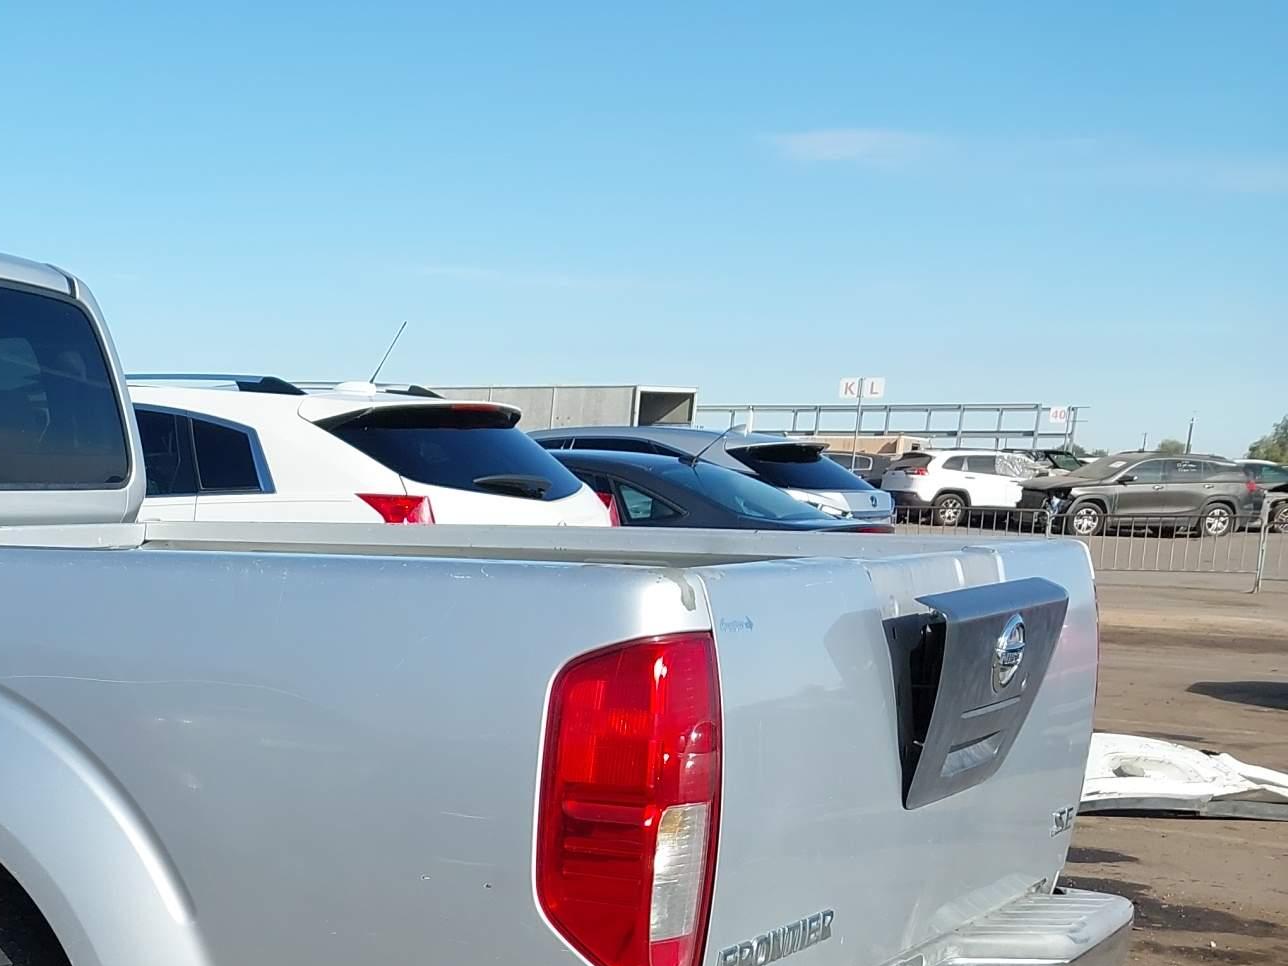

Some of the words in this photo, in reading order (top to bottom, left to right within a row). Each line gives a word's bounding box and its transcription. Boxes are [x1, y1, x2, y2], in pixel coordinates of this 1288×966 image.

[844, 381, 855, 395] K
[870, 381, 879, 395] L
[1051, 409, 1066, 420] 40
[1049, 807, 1074, 838] SE
